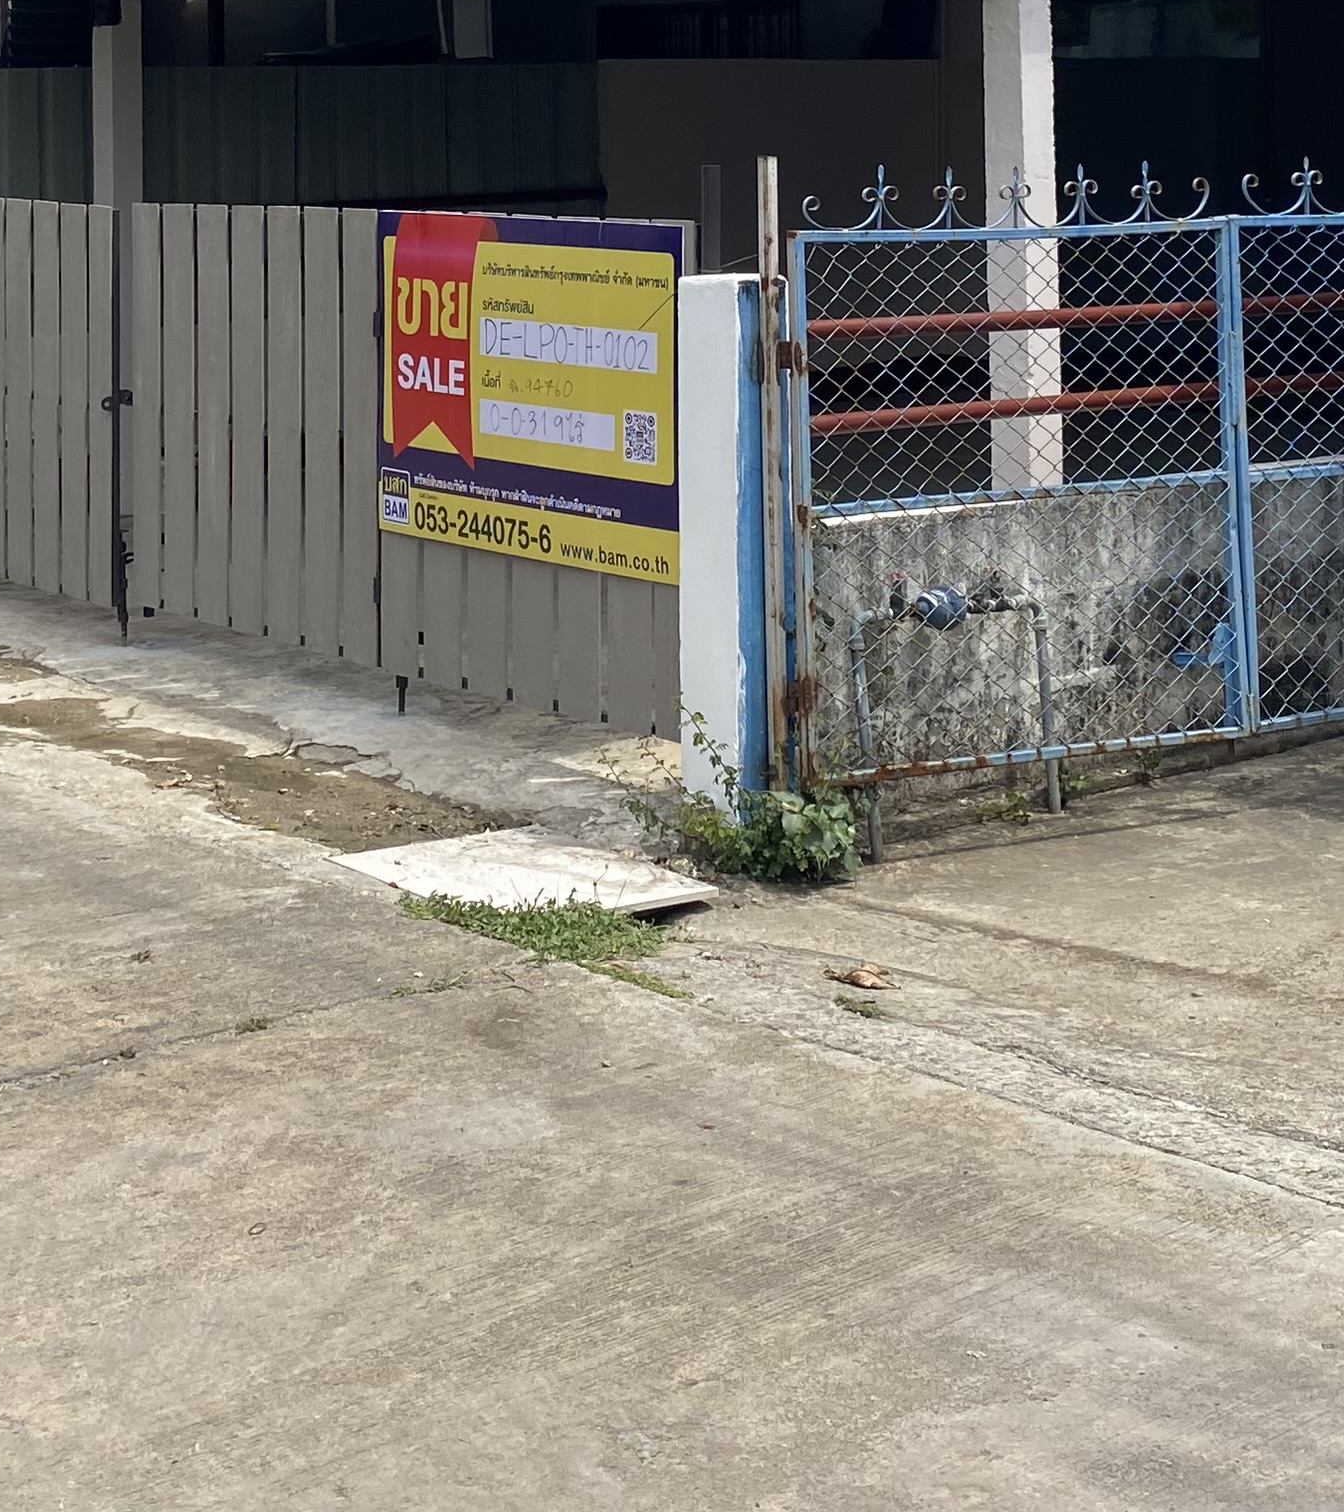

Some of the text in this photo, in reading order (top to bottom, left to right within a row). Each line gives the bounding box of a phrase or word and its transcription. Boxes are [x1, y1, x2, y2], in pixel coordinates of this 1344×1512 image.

[613, 268, 633, 286] จำกัด
[635, 274, 669, 291] (มหาชน)
[397, 277, 468, 340] ขาย
[482, 297, 534, 315] รหัสทรัพย์สิน
[484, 318, 649, 370] DE-LPO-TH-0102
[397, 353, 465, 396] SALE
[481, 369, 501, 388] เนื้อที่
[383, 474, 407, 496] บสก
[385, 498, 408, 520] BAM
[414, 501, 670, 575] 053-244075-6 www.bam.co.th
